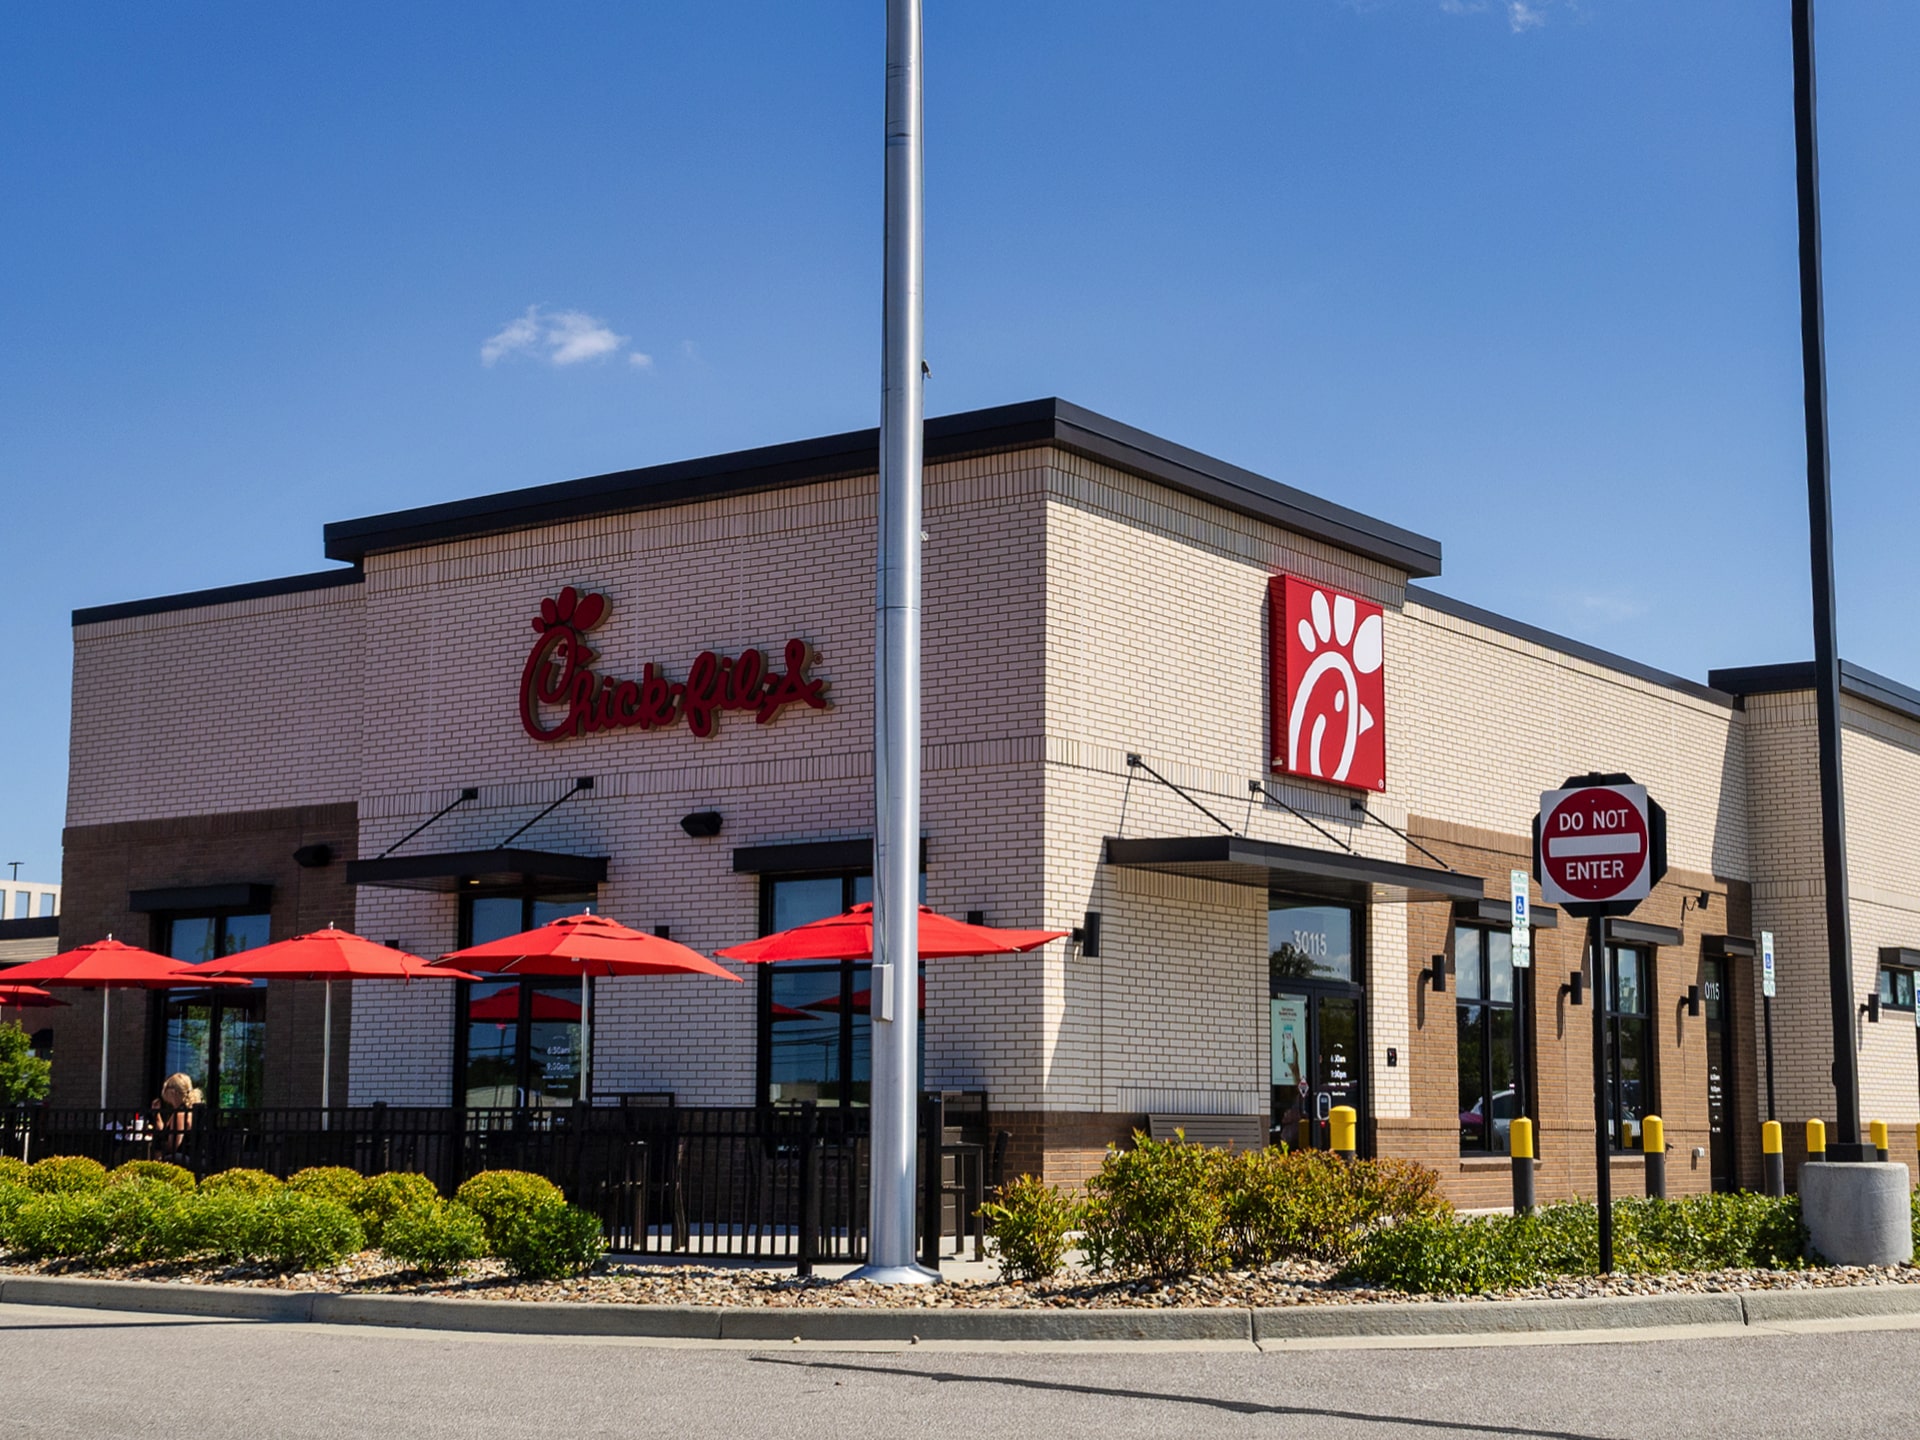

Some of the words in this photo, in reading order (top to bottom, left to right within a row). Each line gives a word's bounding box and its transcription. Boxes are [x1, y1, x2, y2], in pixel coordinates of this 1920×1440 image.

[519, 586, 828, 741] Chick-fil-A
[1559, 812, 1584, 831] DO
[1592, 809, 1629, 829] NOT
[1565, 860, 1625, 881] ENTER
[1293, 930, 1327, 956] 30115
